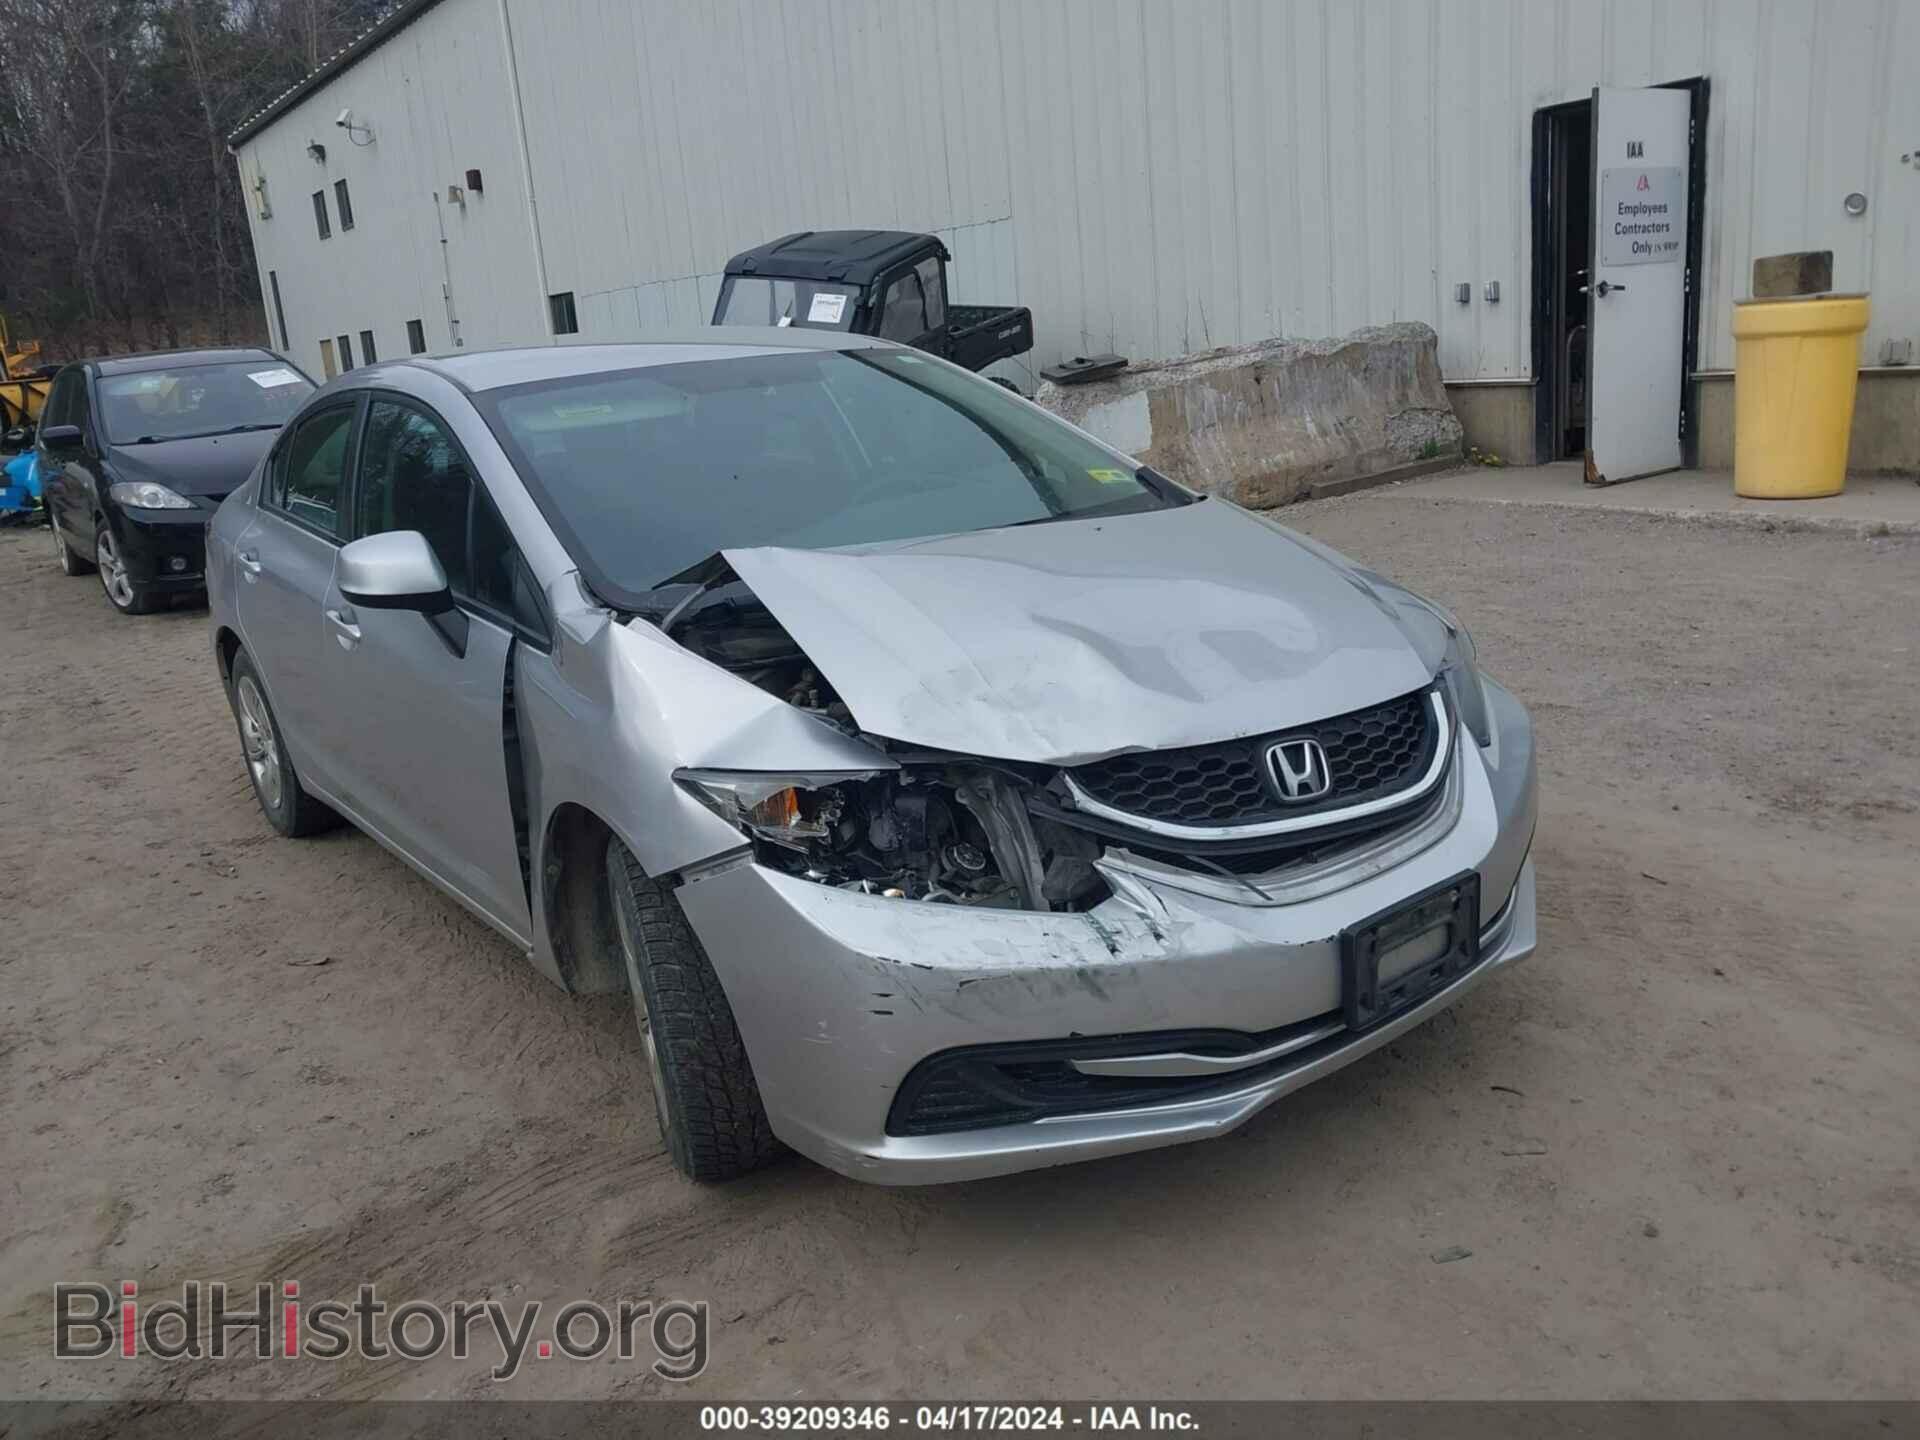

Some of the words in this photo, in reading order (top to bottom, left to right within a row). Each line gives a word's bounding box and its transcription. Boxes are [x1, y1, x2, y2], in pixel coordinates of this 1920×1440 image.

[1626, 141, 1644, 159] IAA
[1618, 202, 1668, 217] Employees
[1615, 222, 1670, 235] Contractors
[1632, 240, 1652, 256] Only
